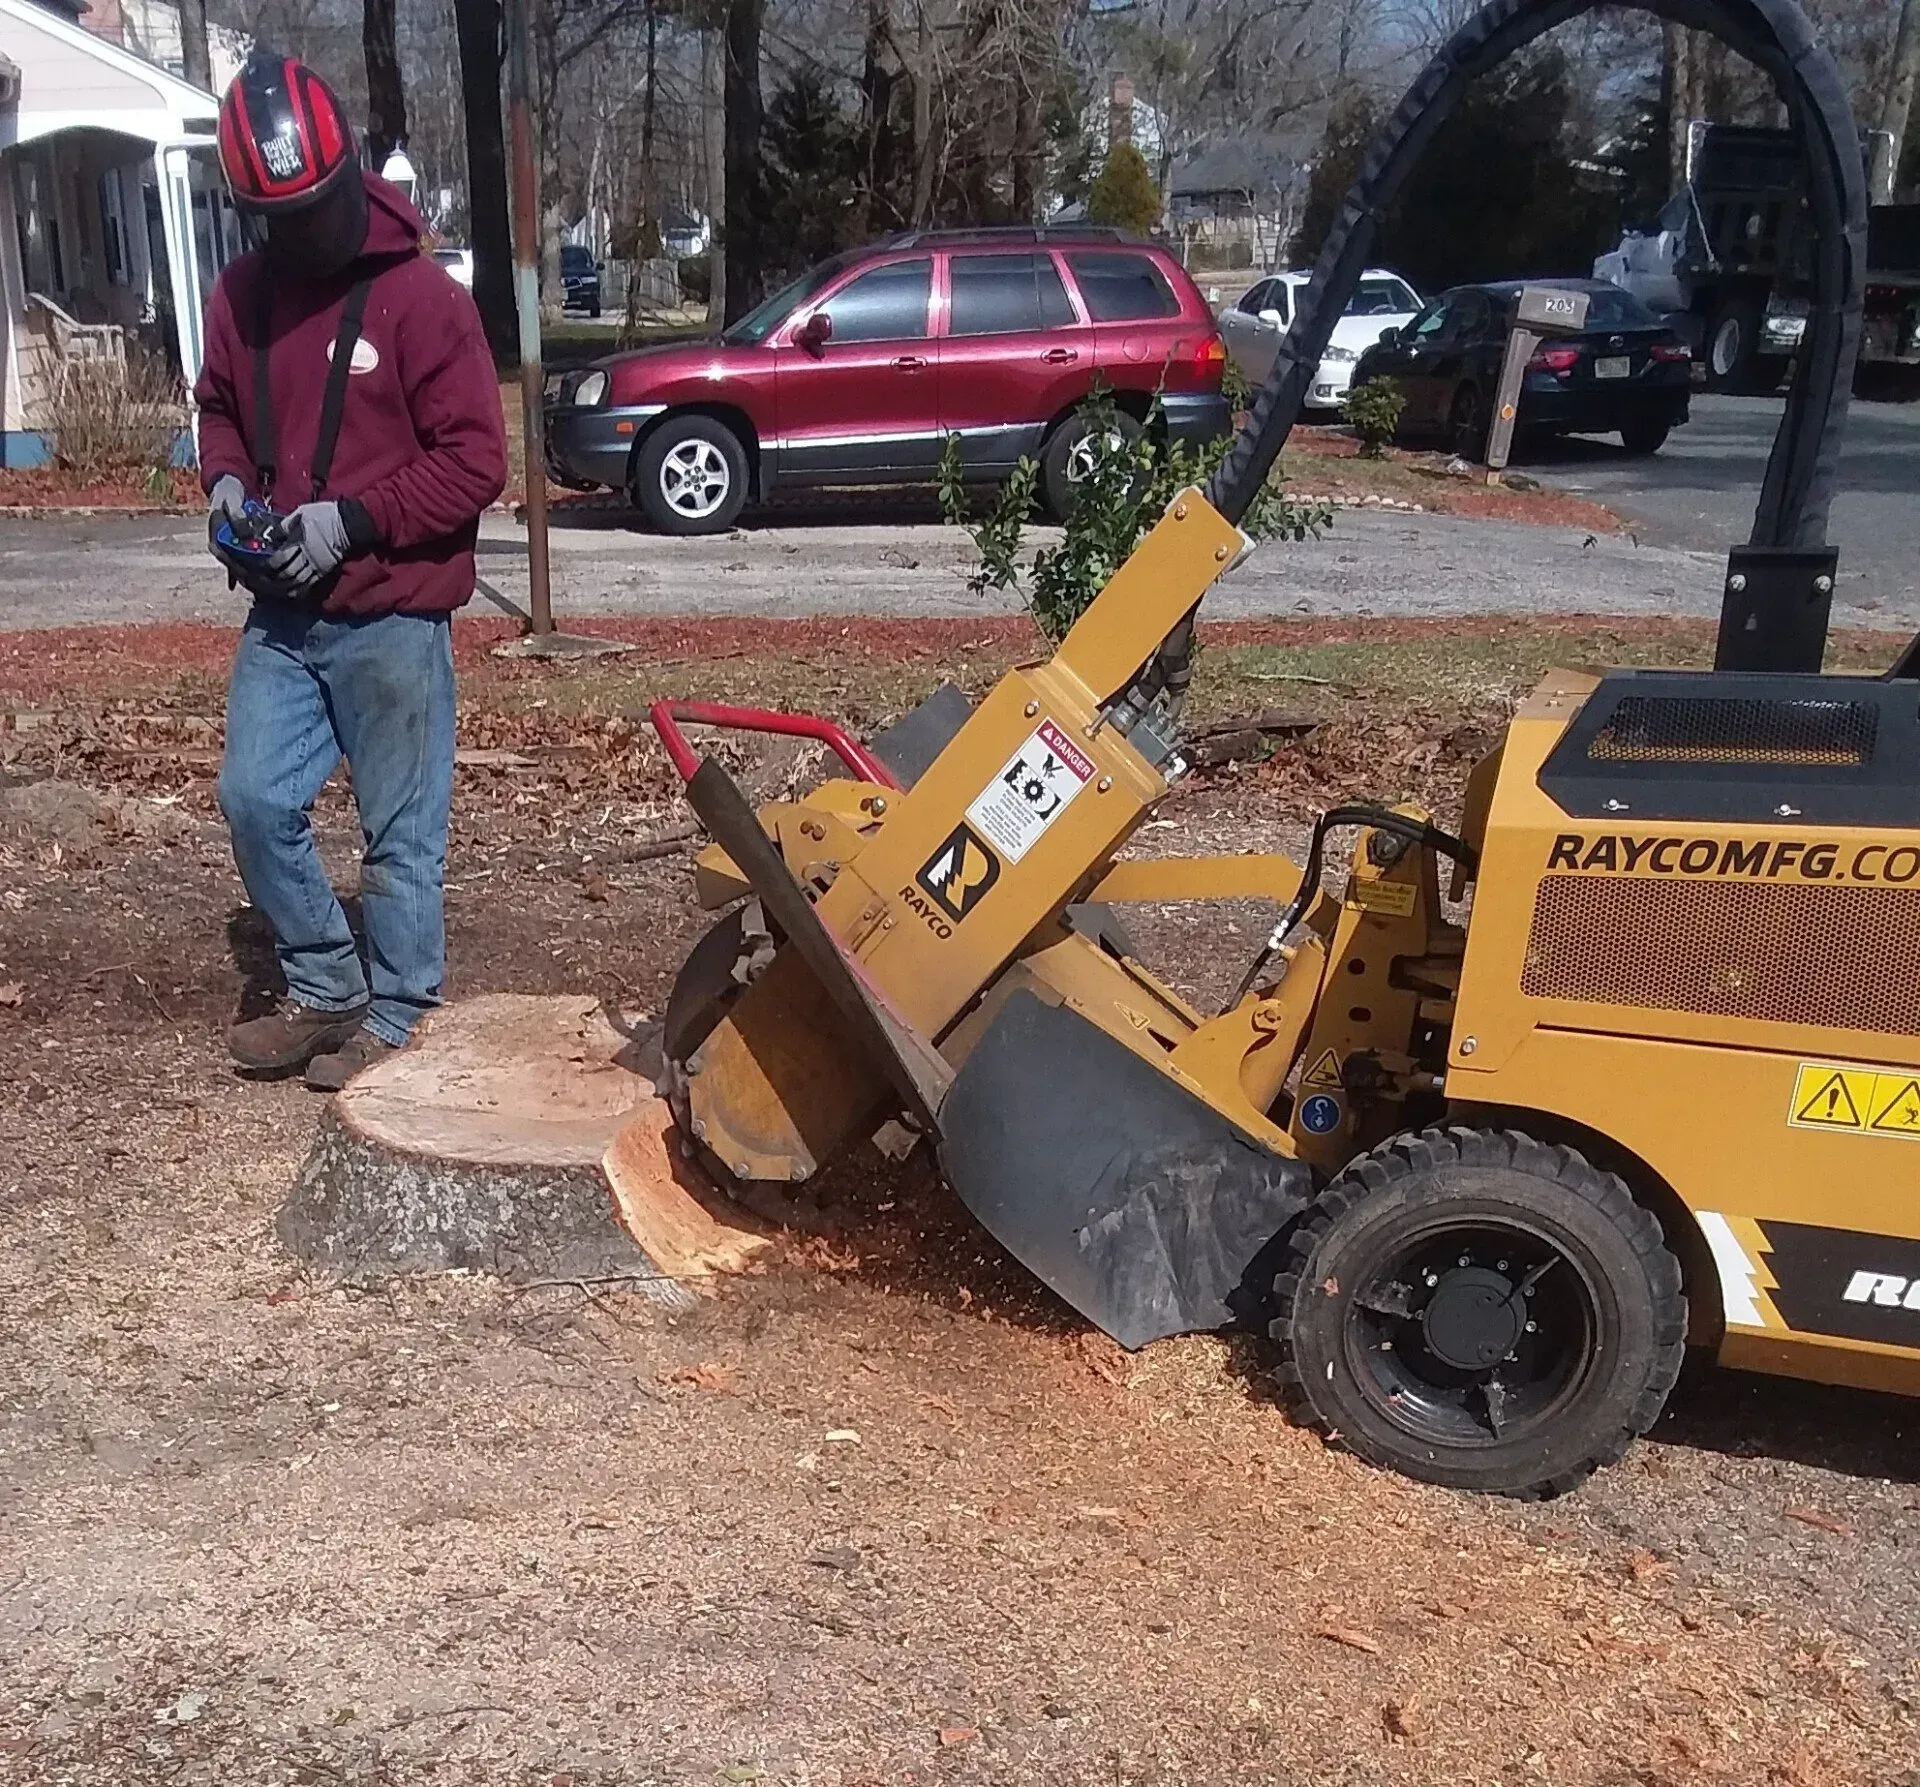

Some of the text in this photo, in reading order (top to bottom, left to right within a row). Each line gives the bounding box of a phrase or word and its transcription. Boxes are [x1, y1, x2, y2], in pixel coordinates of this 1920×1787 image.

[1546, 299, 1573, 313] 203
[1052, 735, 1091, 778] DANGER
[898, 885, 952, 940] RAYCO
